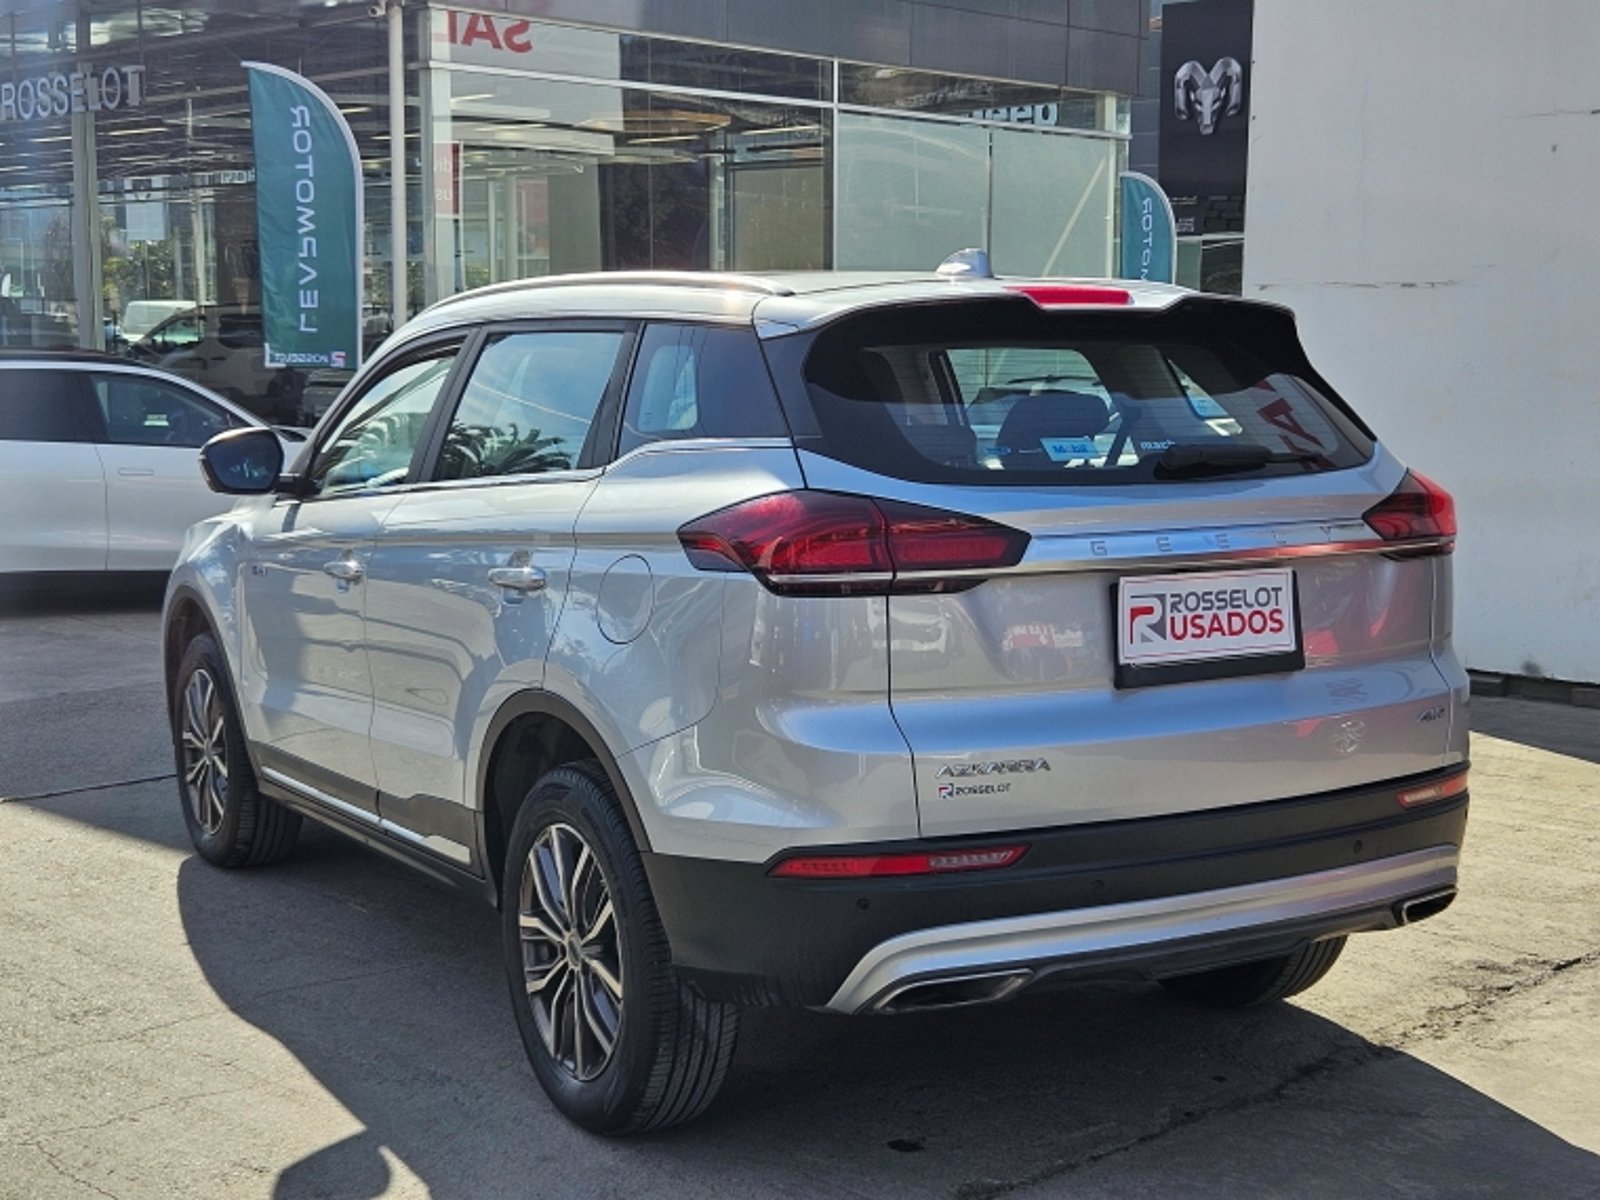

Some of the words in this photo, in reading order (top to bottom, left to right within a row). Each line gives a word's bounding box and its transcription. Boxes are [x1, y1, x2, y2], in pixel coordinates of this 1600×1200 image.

[1, 65, 146, 120] ROSSELOT
[1089, 525, 1333, 557] GEELY
[1169, 587, 1283, 614] ROSSELOT
[1170, 608, 1285, 641] USADOS
[955, 782, 1012, 796] ROSSELOT
